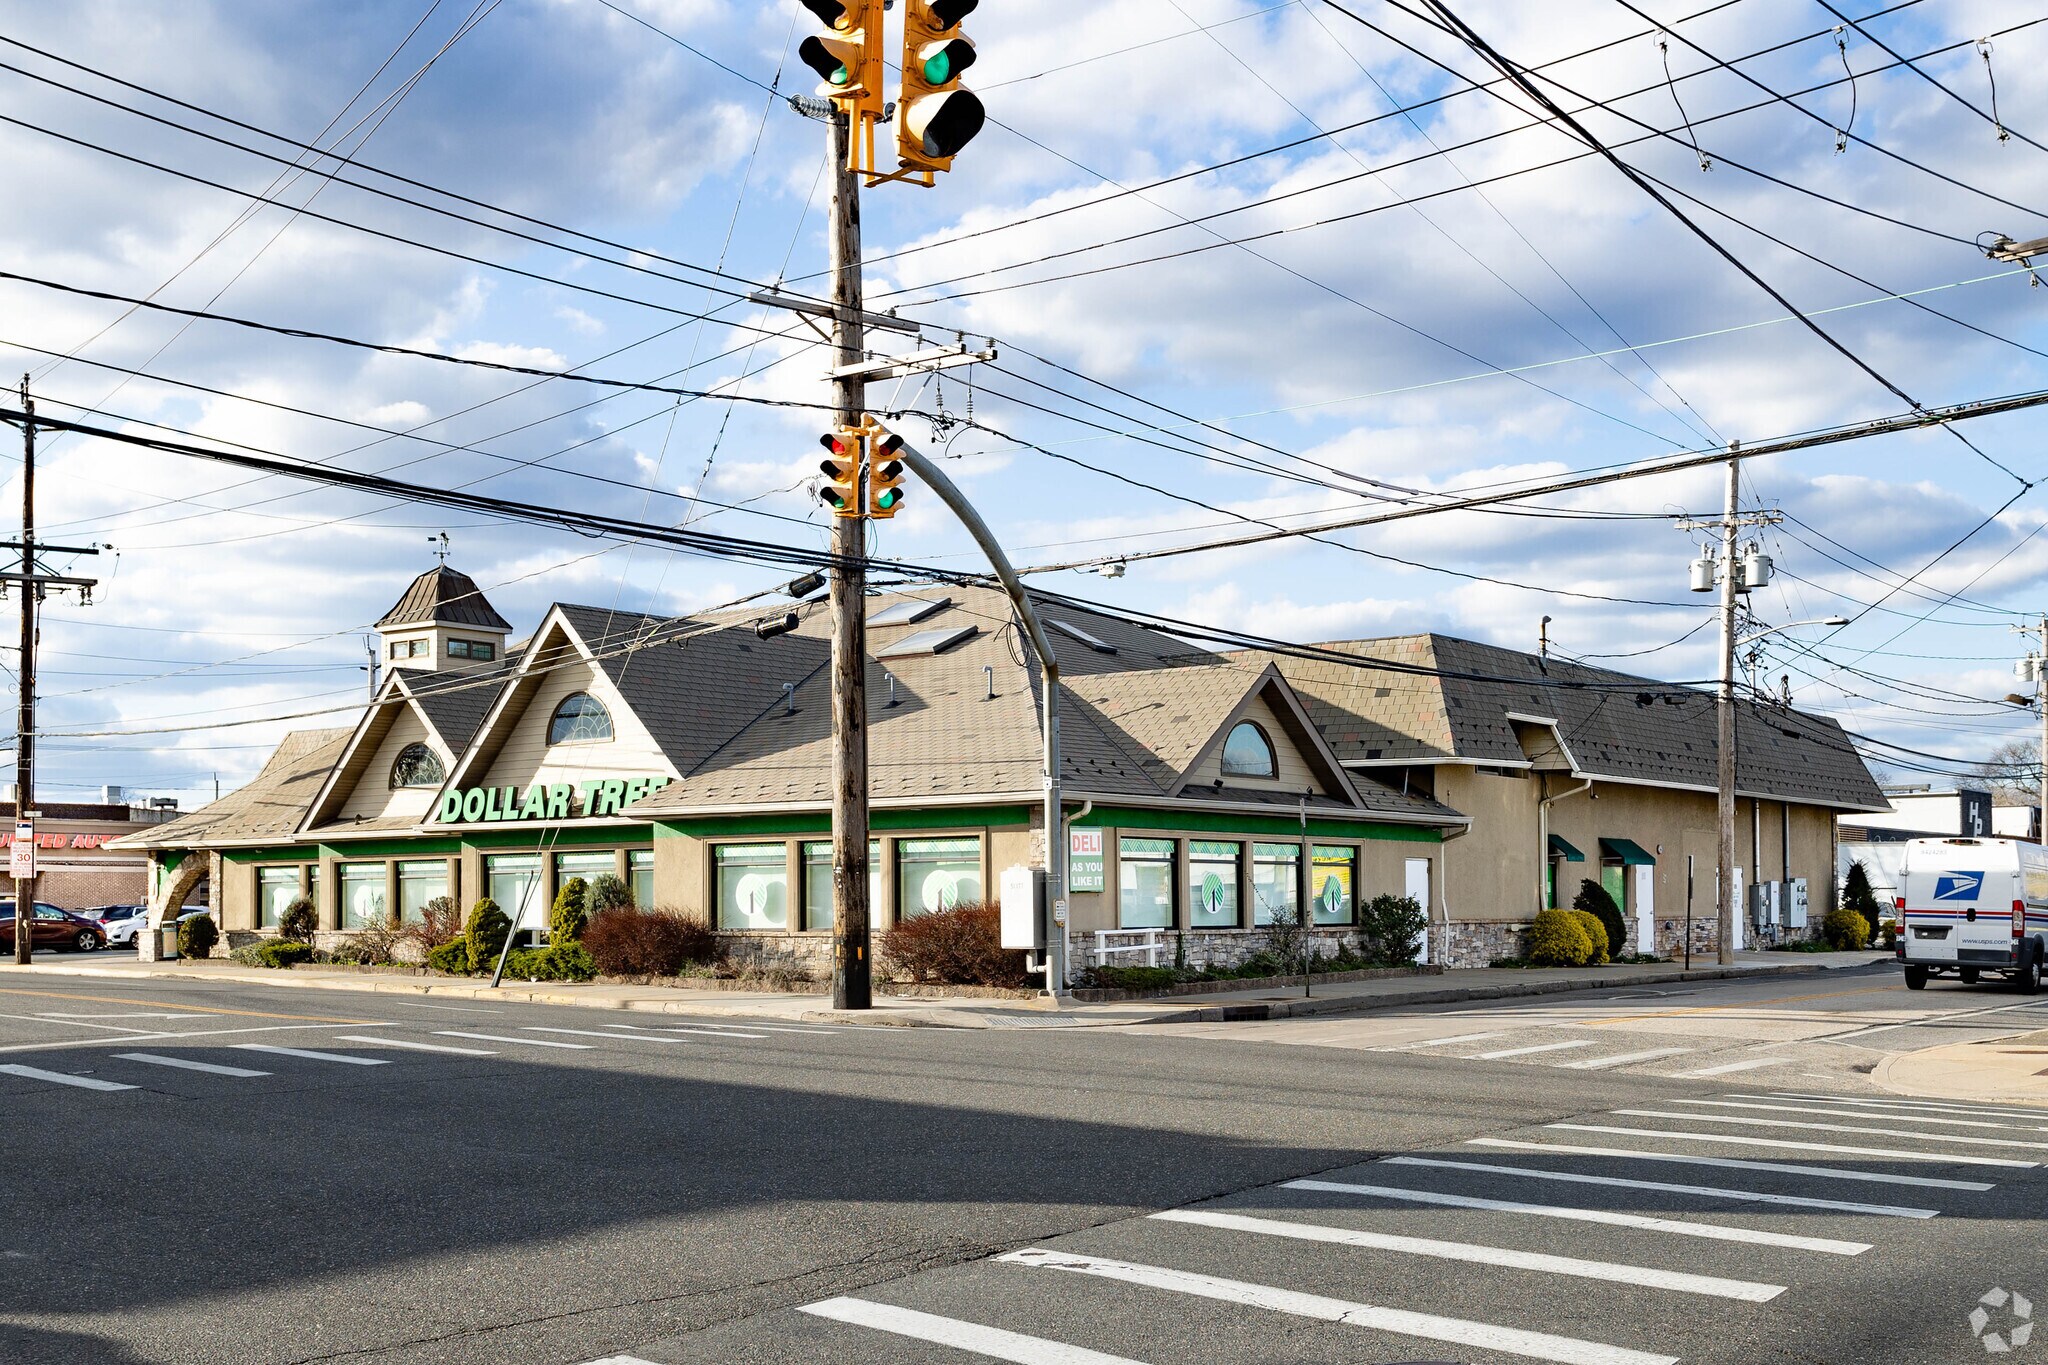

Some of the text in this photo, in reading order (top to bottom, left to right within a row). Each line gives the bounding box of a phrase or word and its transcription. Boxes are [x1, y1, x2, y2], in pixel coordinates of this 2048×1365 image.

[440, 783, 574, 823] DOLLAR
[1072, 834, 1101, 852] DELI
[17, 853, 30, 862] 30
[1072, 862, 1103, 872] AS YOU
[1072, 876, 1103, 886] LIKE IT
